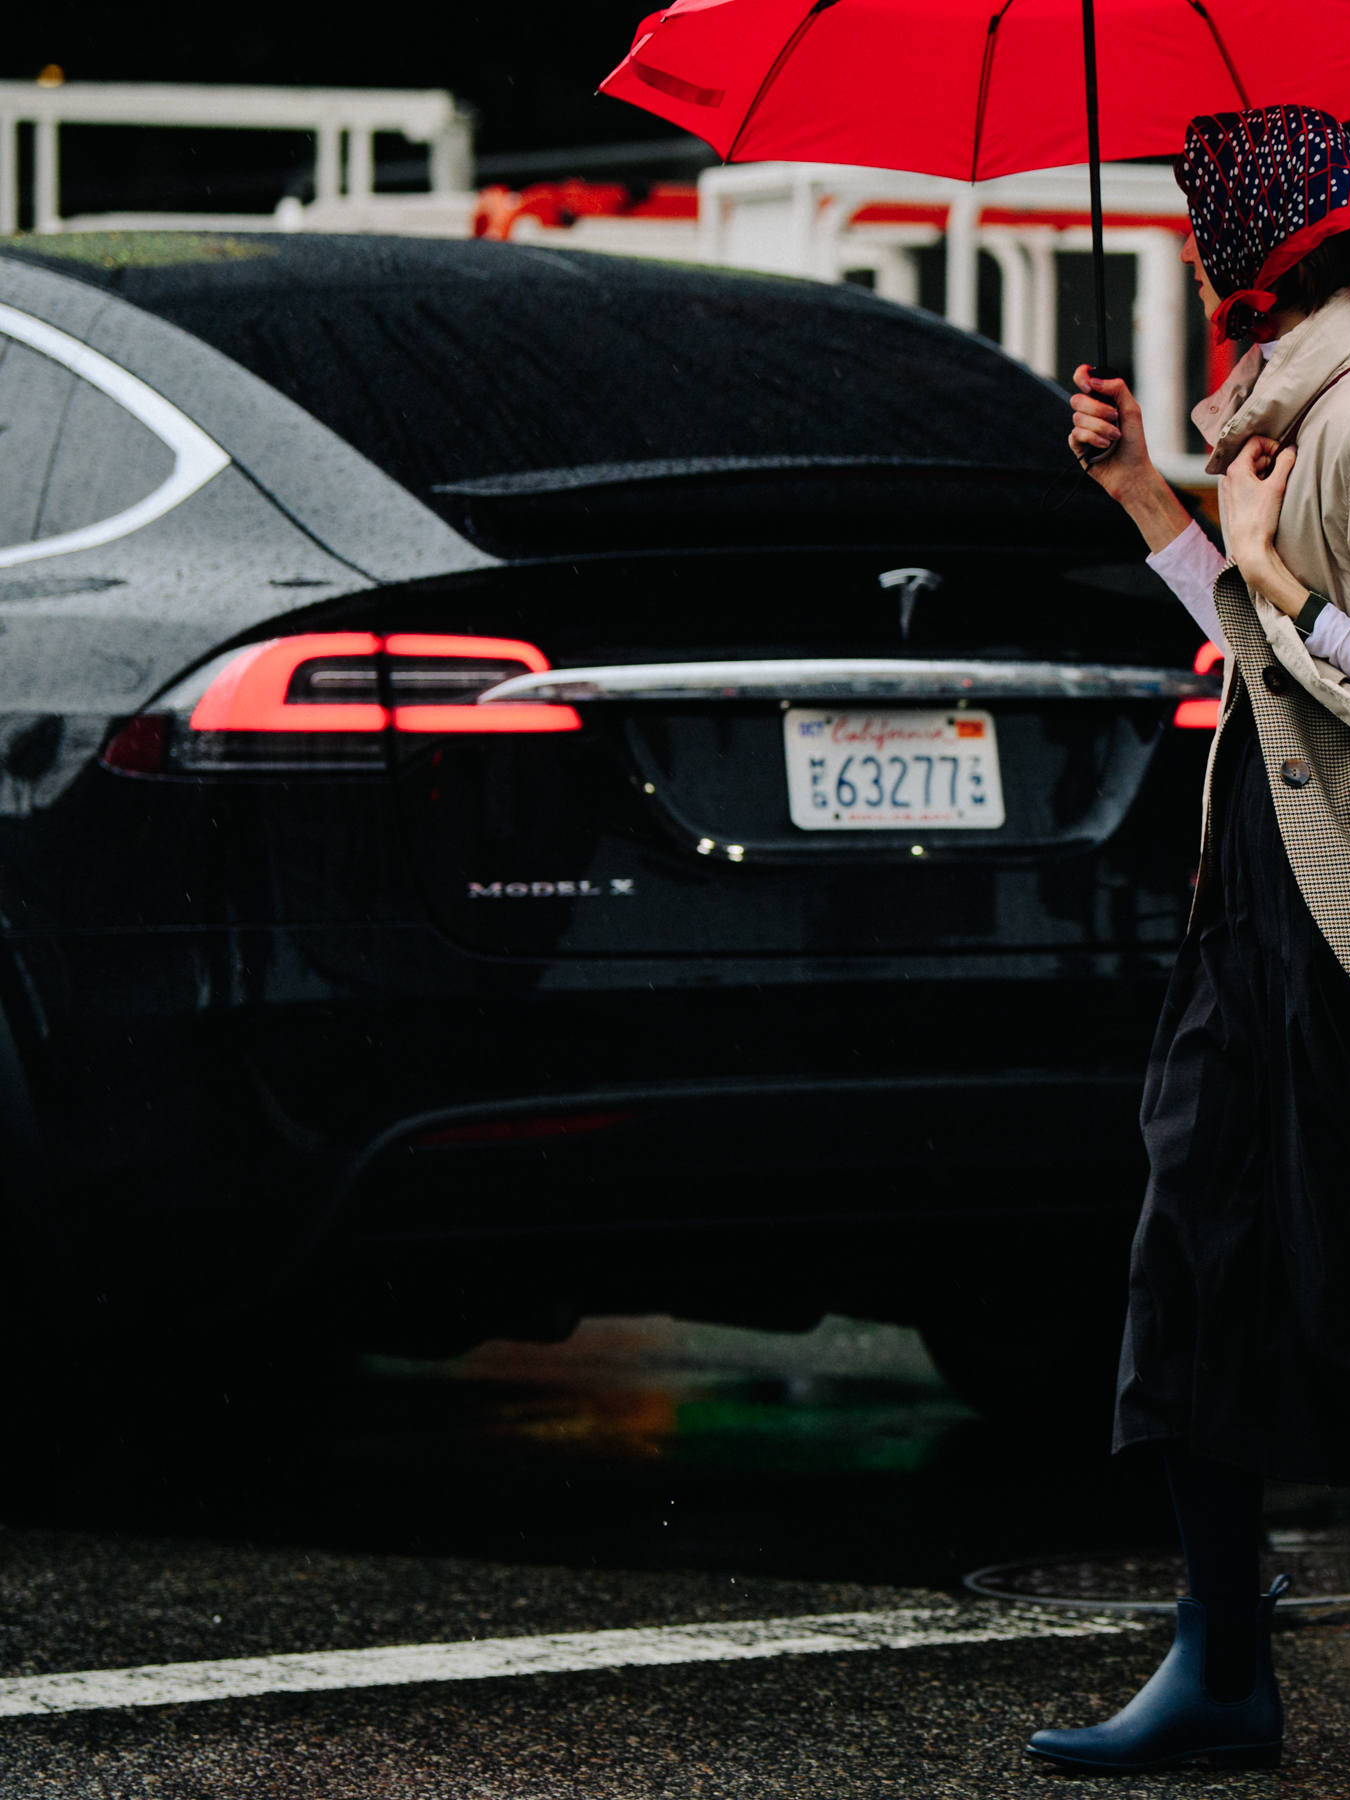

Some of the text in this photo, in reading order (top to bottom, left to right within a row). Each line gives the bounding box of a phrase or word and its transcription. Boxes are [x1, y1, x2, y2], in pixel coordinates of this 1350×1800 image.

[831, 717, 945, 751] California
[836, 754, 960, 808] 63277
[467, 878, 637, 899] MODEL X
